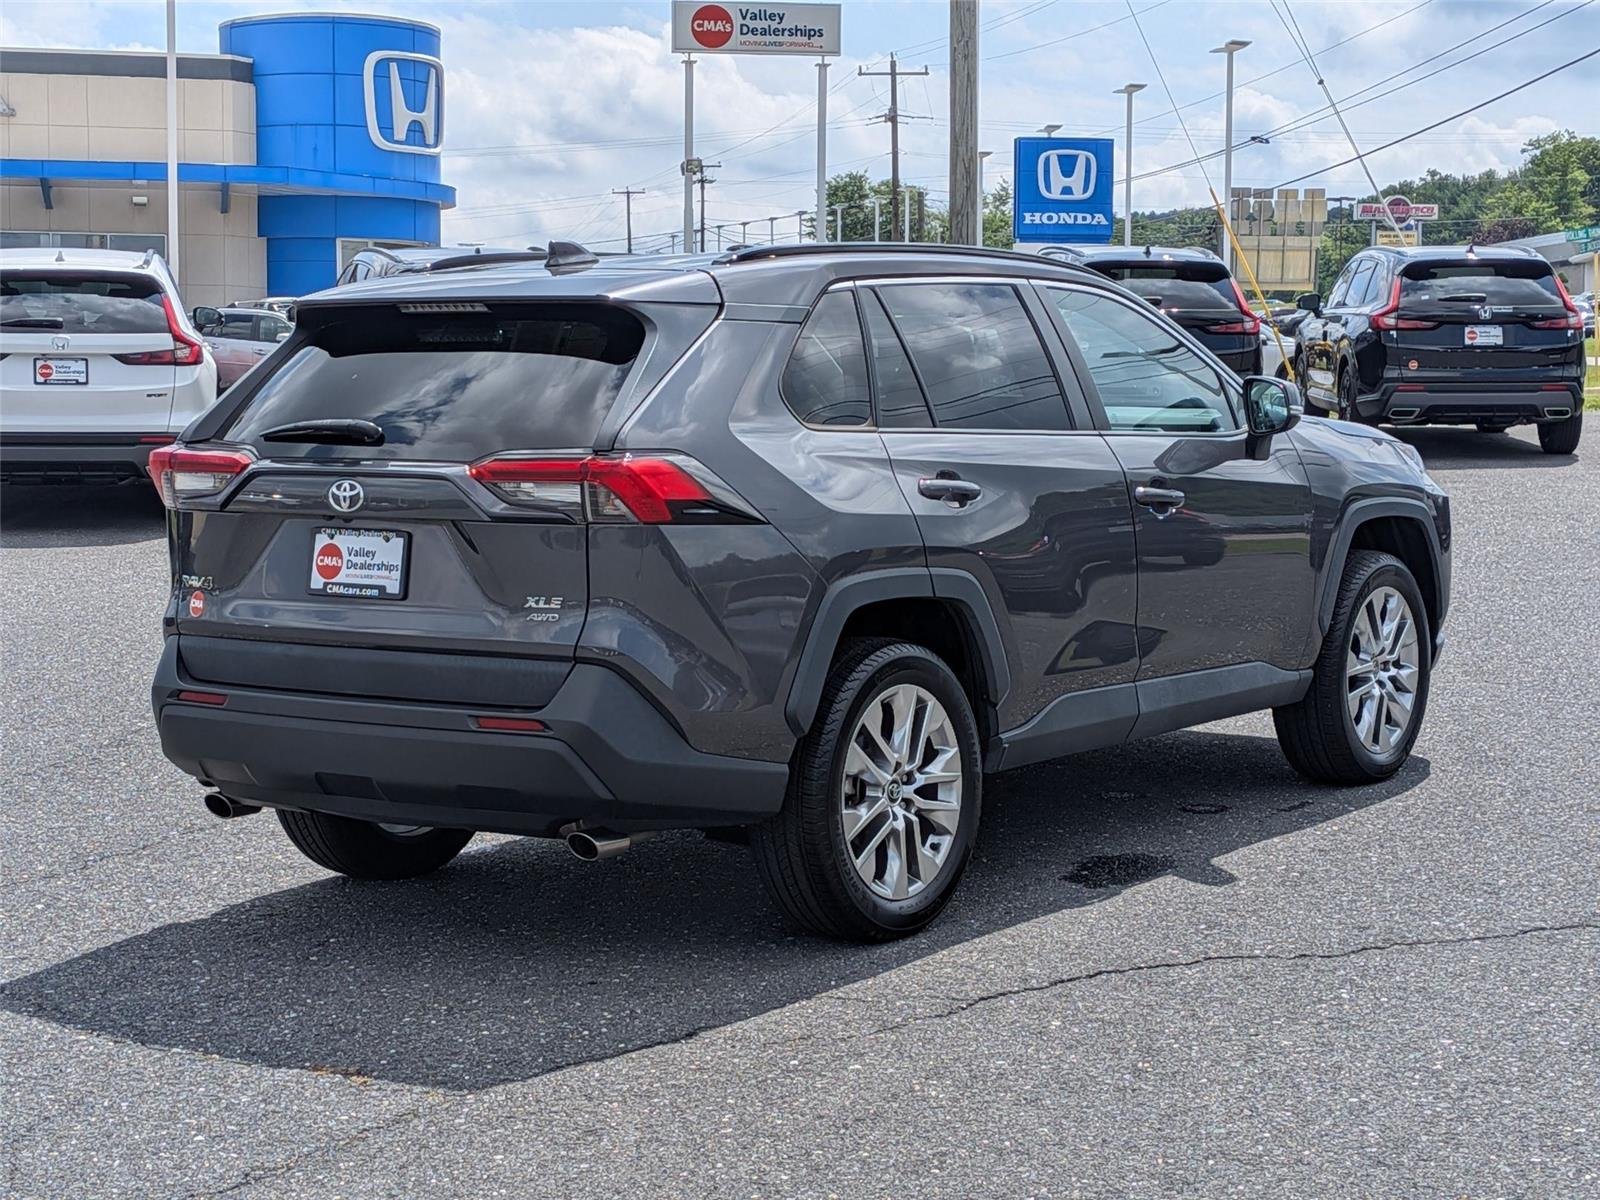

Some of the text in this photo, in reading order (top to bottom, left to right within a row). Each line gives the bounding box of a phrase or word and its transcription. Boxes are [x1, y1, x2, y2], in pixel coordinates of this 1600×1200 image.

[738, 8, 785, 24] Valley
[693, 20, 733, 32] CMA's
[739, 24, 824, 40] Dealerships
[1022, 212, 1109, 225] HONDA
[347, 546, 377, 560] Valley
[317, 556, 342, 567] CMA's
[346, 560, 400, 575] Dealerships
[326, 584, 379, 596] CMAcars.com
[523, 596, 564, 609] XLE
[526, 613, 559, 622] AWD
